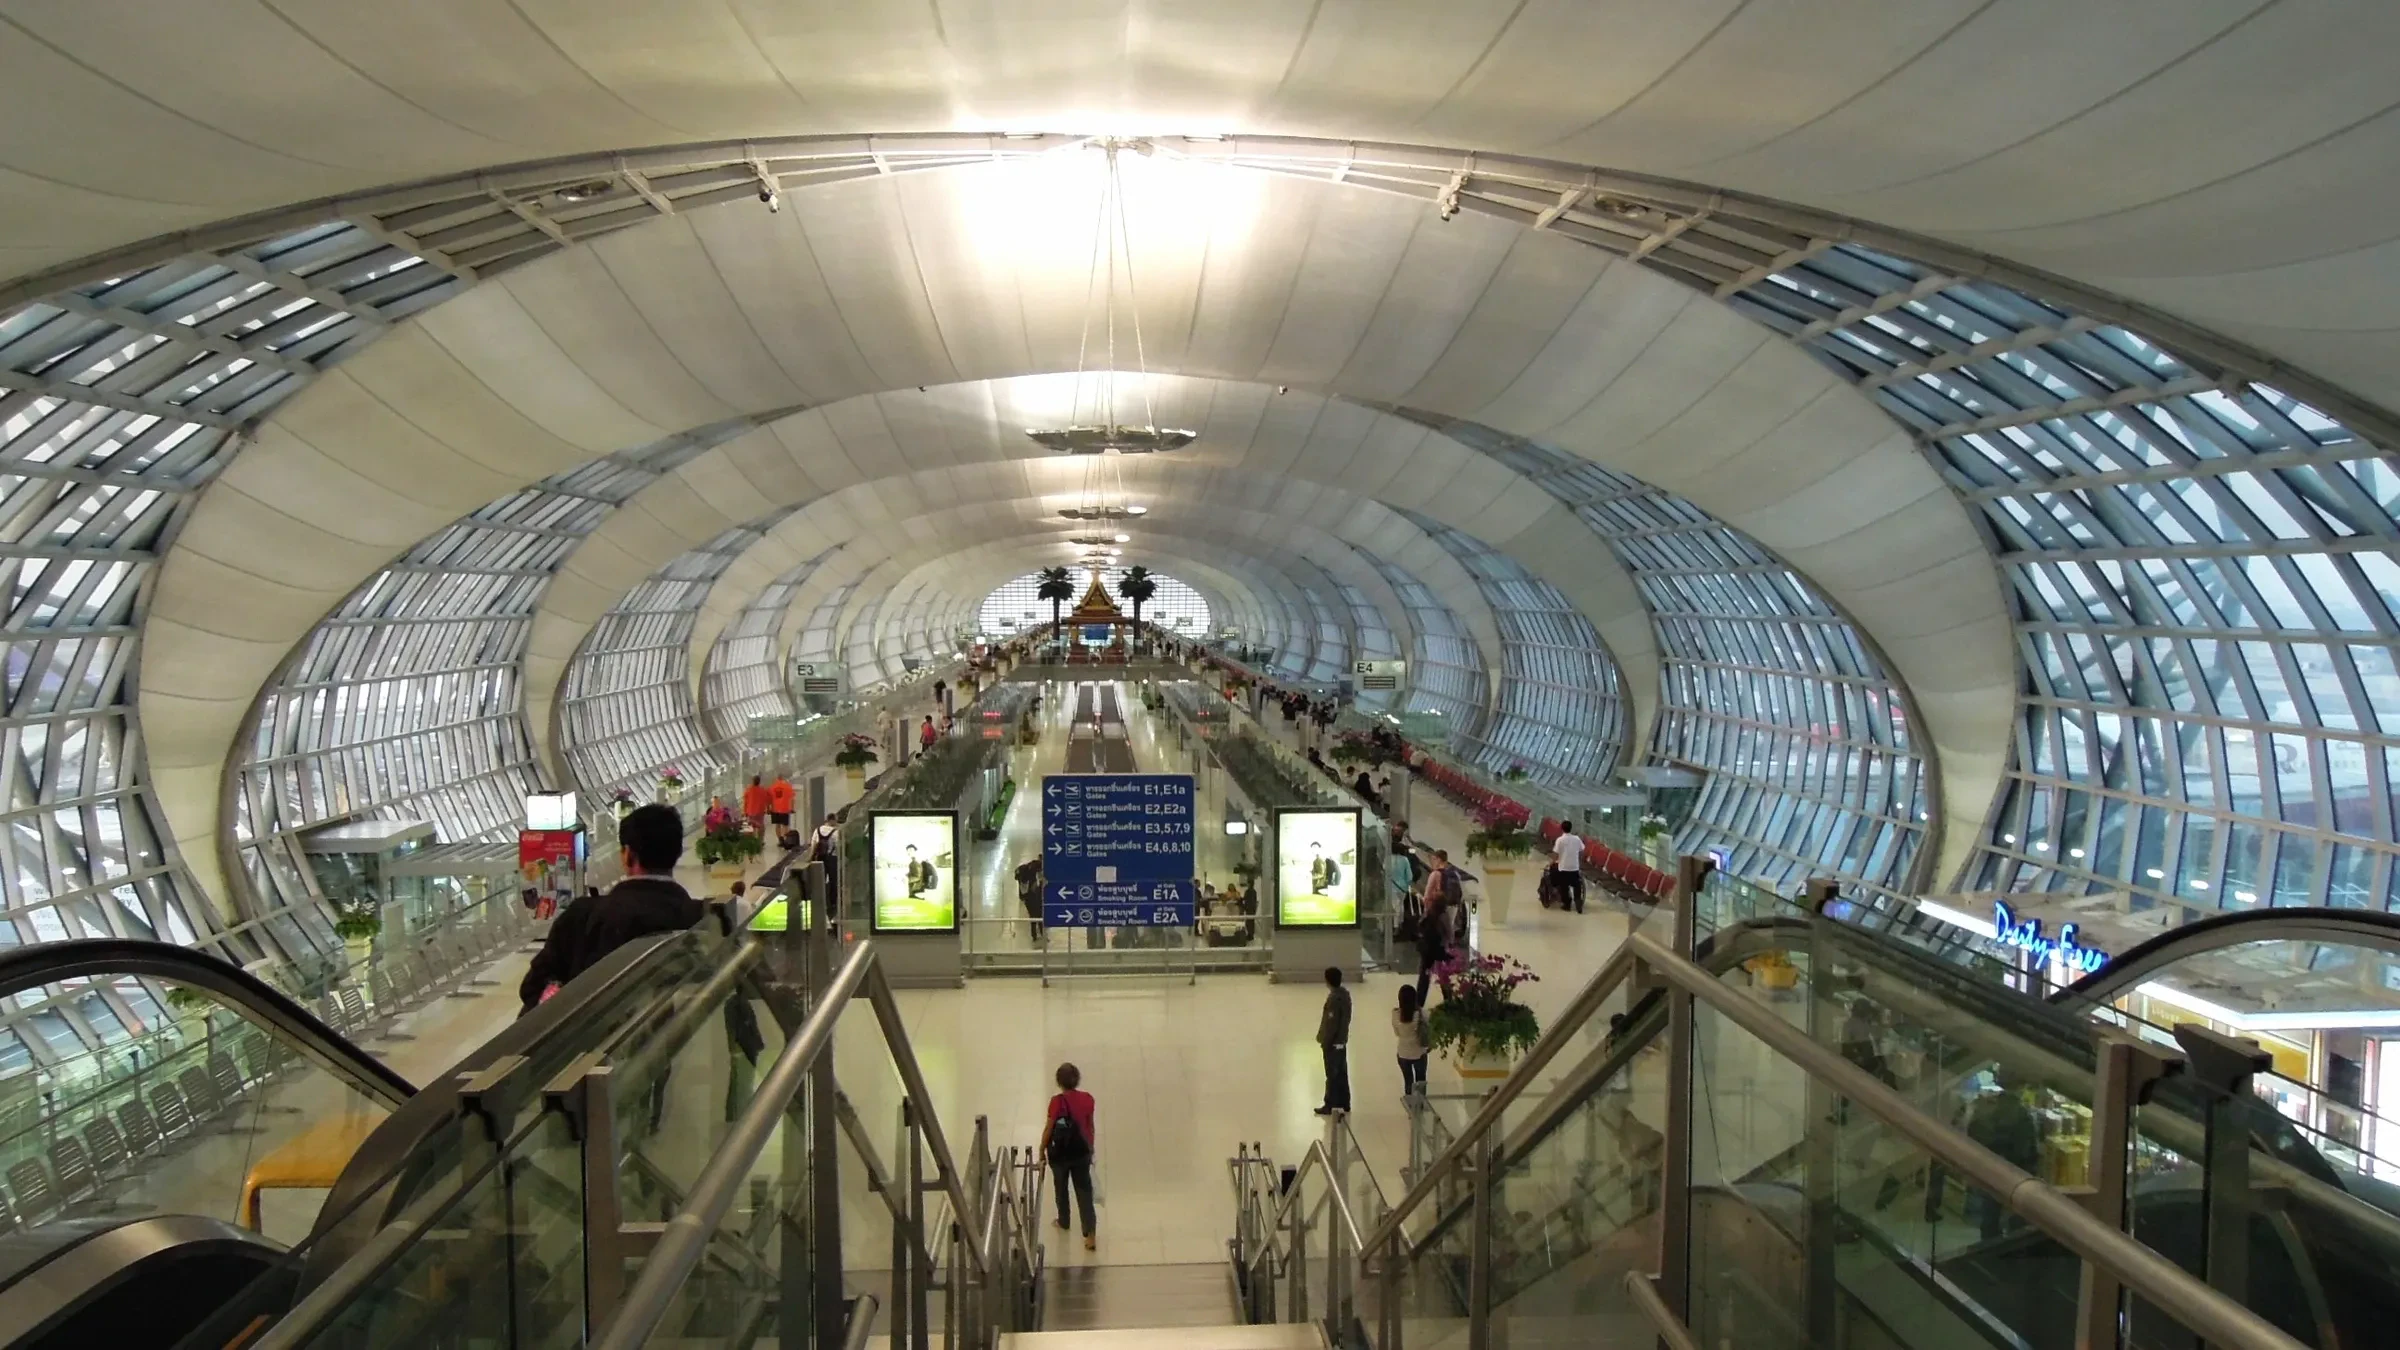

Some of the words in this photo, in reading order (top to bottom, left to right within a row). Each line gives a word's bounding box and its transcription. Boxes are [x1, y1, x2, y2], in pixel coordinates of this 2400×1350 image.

[797, 664, 814, 676] E3
[1357, 662, 1373, 673] E4
[1144, 784, 1186, 797] E1,E1a
[1145, 804, 1186, 815] E2,E2a
[1145, 823, 1191, 835] E3,5,7,9
[1145, 842, 1191, 854] E4,6,8,10
[1153, 889, 1180, 900] E1A
[1153, 912, 1180, 923] E2A
[1994, 900, 2050, 970] Duty
[2057, 923, 2107, 973] Free
